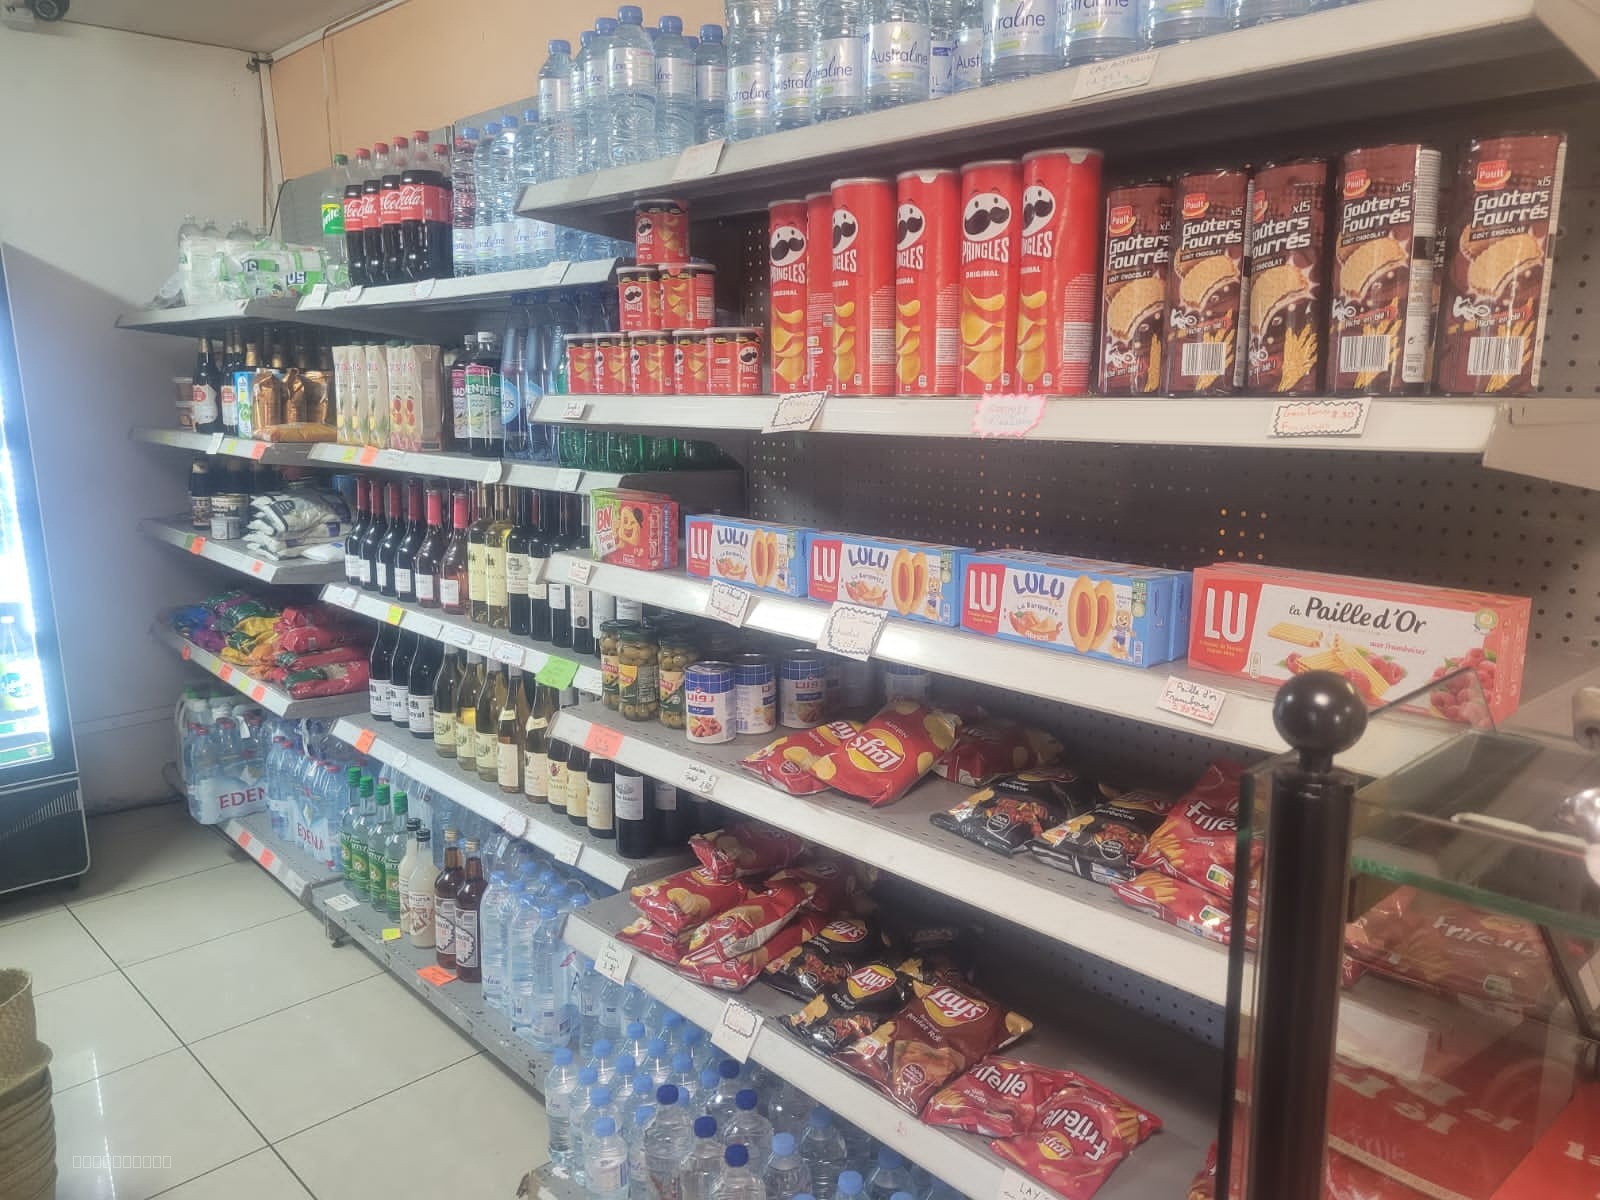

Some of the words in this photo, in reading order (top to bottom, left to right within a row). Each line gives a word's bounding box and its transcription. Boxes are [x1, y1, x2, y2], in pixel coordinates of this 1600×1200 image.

[1343, 210, 1411, 235] Fourrés
[1472, 205, 1549, 229] Fourrés
[962, 236, 1010, 265] PRINGLES
[1181, 231, 1243, 251] Fourrés
[1253, 232, 1312, 259] ourrés
[770, 262, 806, 285] PRINGLES
[596, 505, 613, 532] BN
[691, 527, 708, 560] LU
[717, 528, 749, 548] LULU
[813, 545, 836, 583] LU
[848, 547, 889, 570] LULU
[969, 569, 998, 613] LU
[1013, 572, 1065, 600] LULU
[1205, 587, 1249, 643] LU
